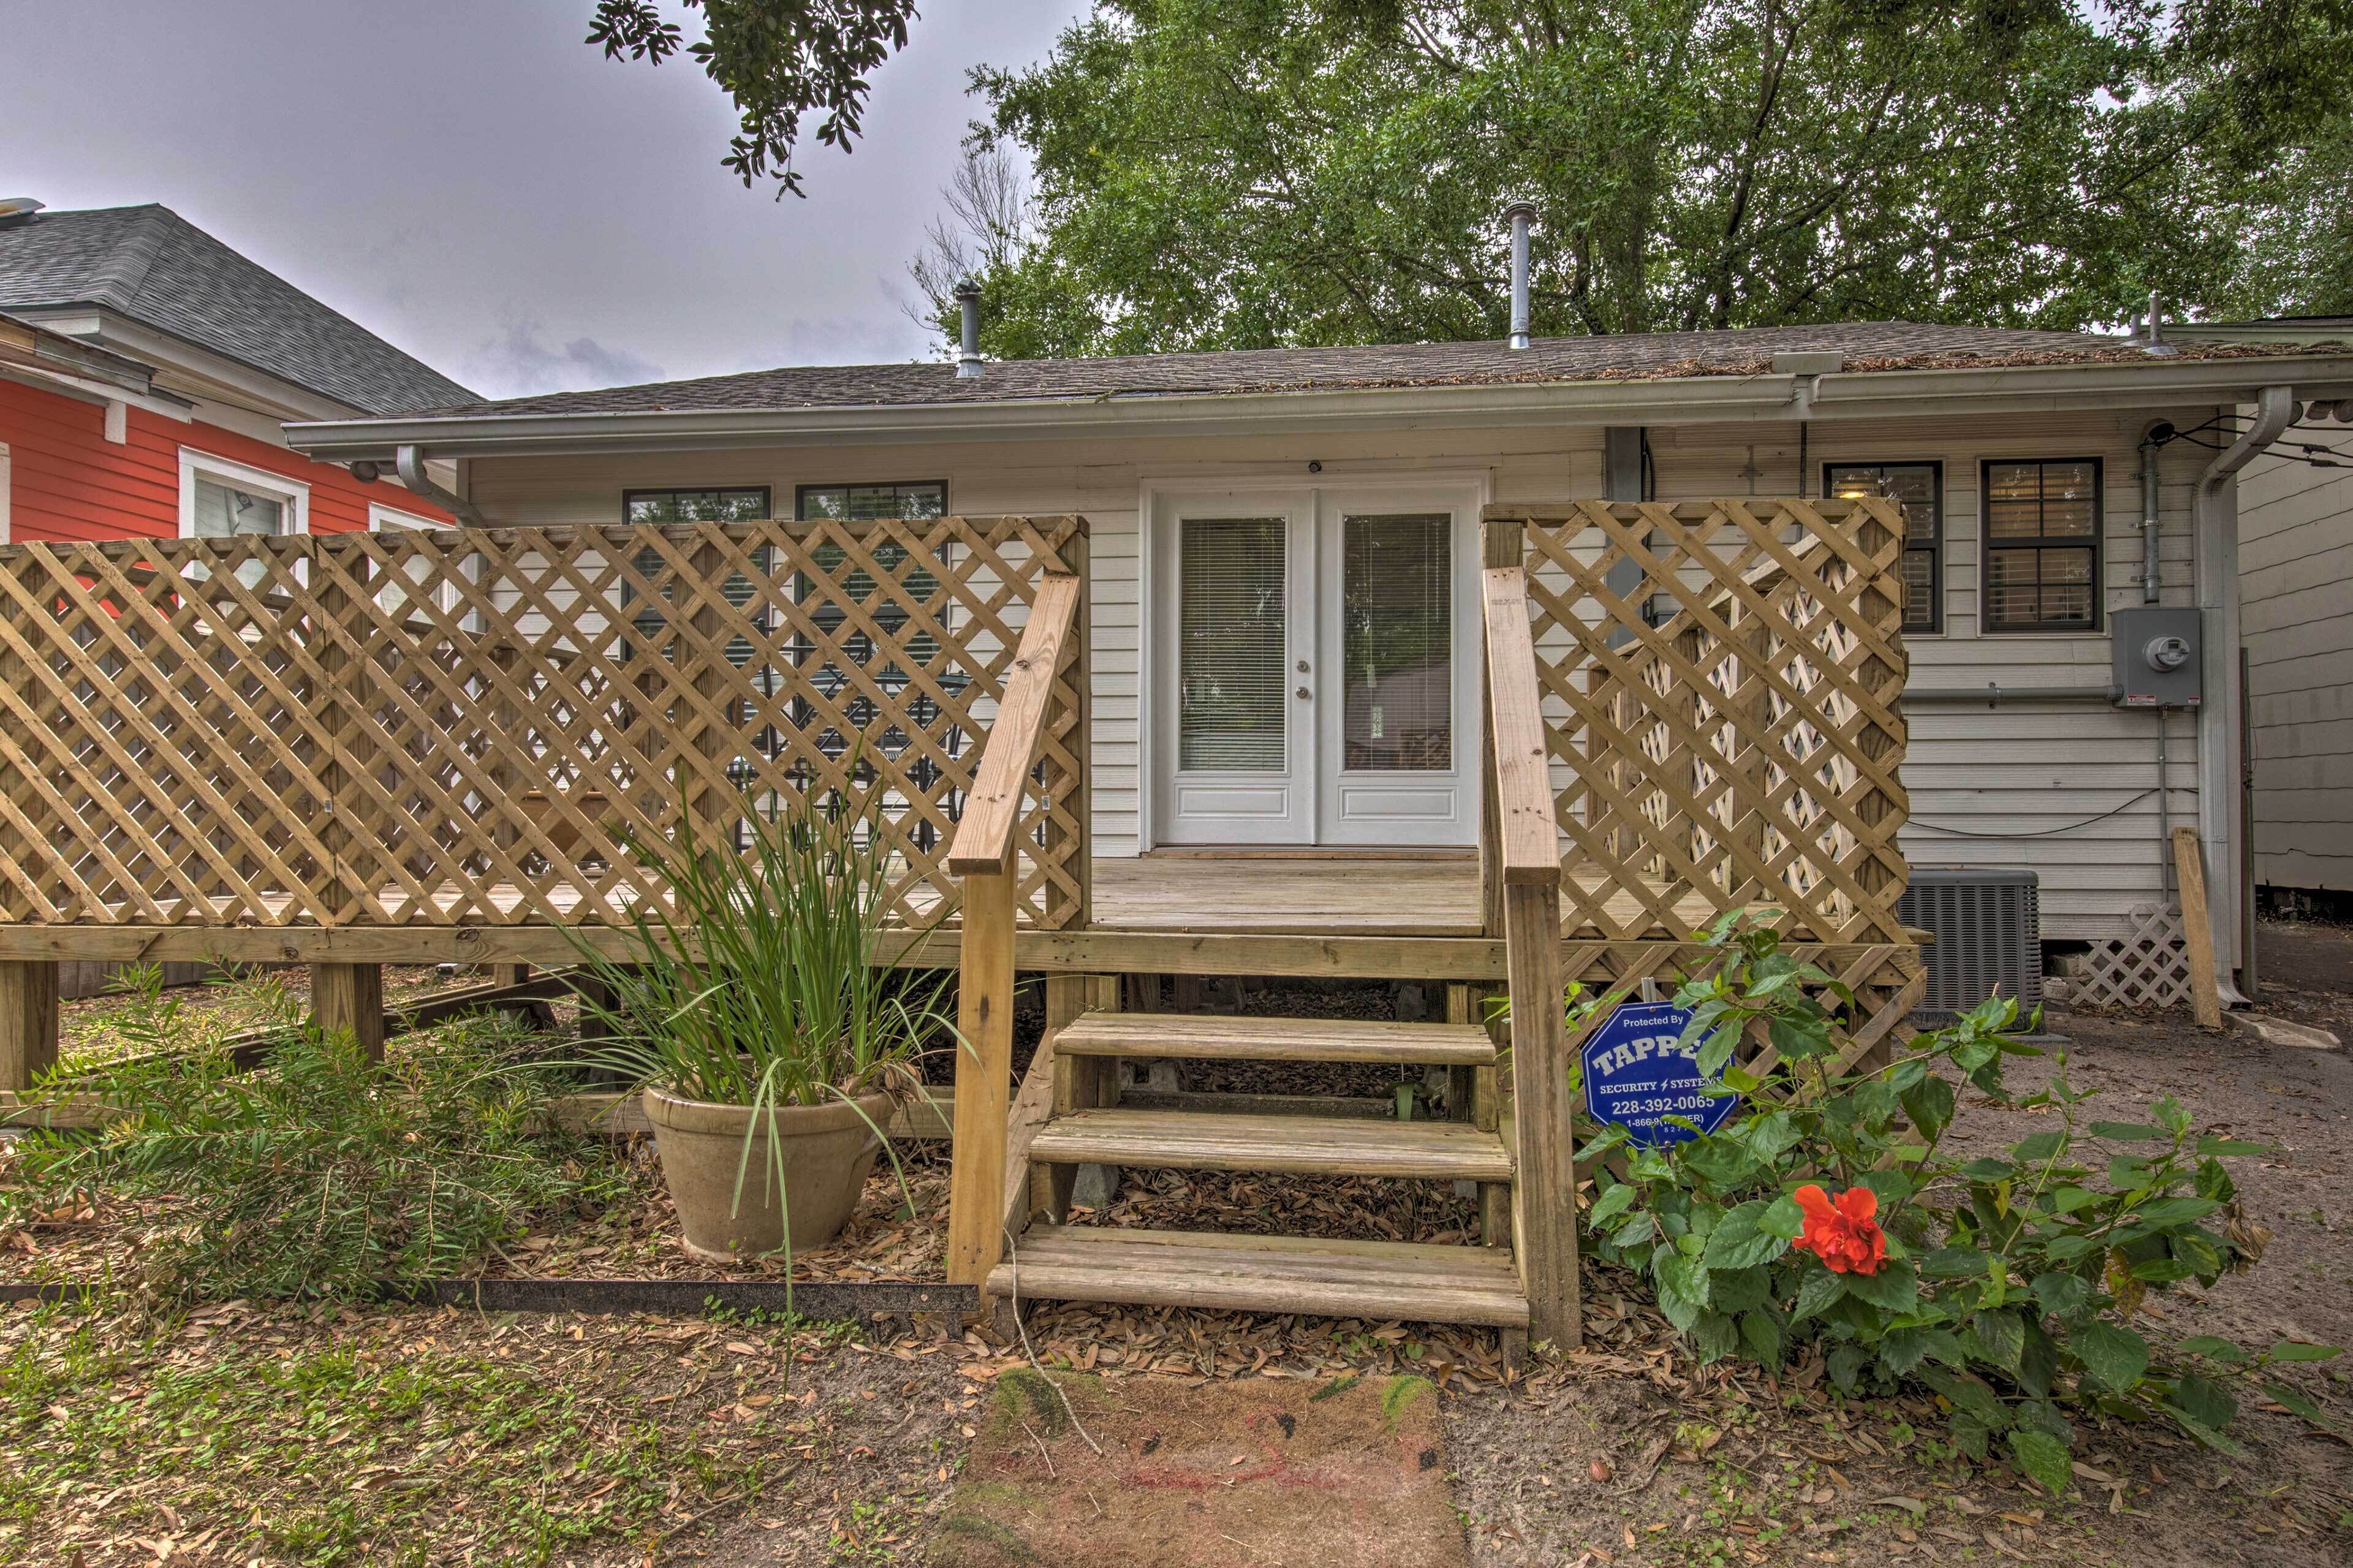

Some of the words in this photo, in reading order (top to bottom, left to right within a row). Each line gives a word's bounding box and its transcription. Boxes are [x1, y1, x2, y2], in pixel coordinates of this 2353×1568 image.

[1624, 1016, 1669, 1027] Protected
[1671, 1015, 1684, 1025] By
[1592, 1036, 1706, 1077] TAPPE
[1600, 1081, 1657, 1094] SECURITY
[1612, 1095, 1715, 1115] 228-392-0065
